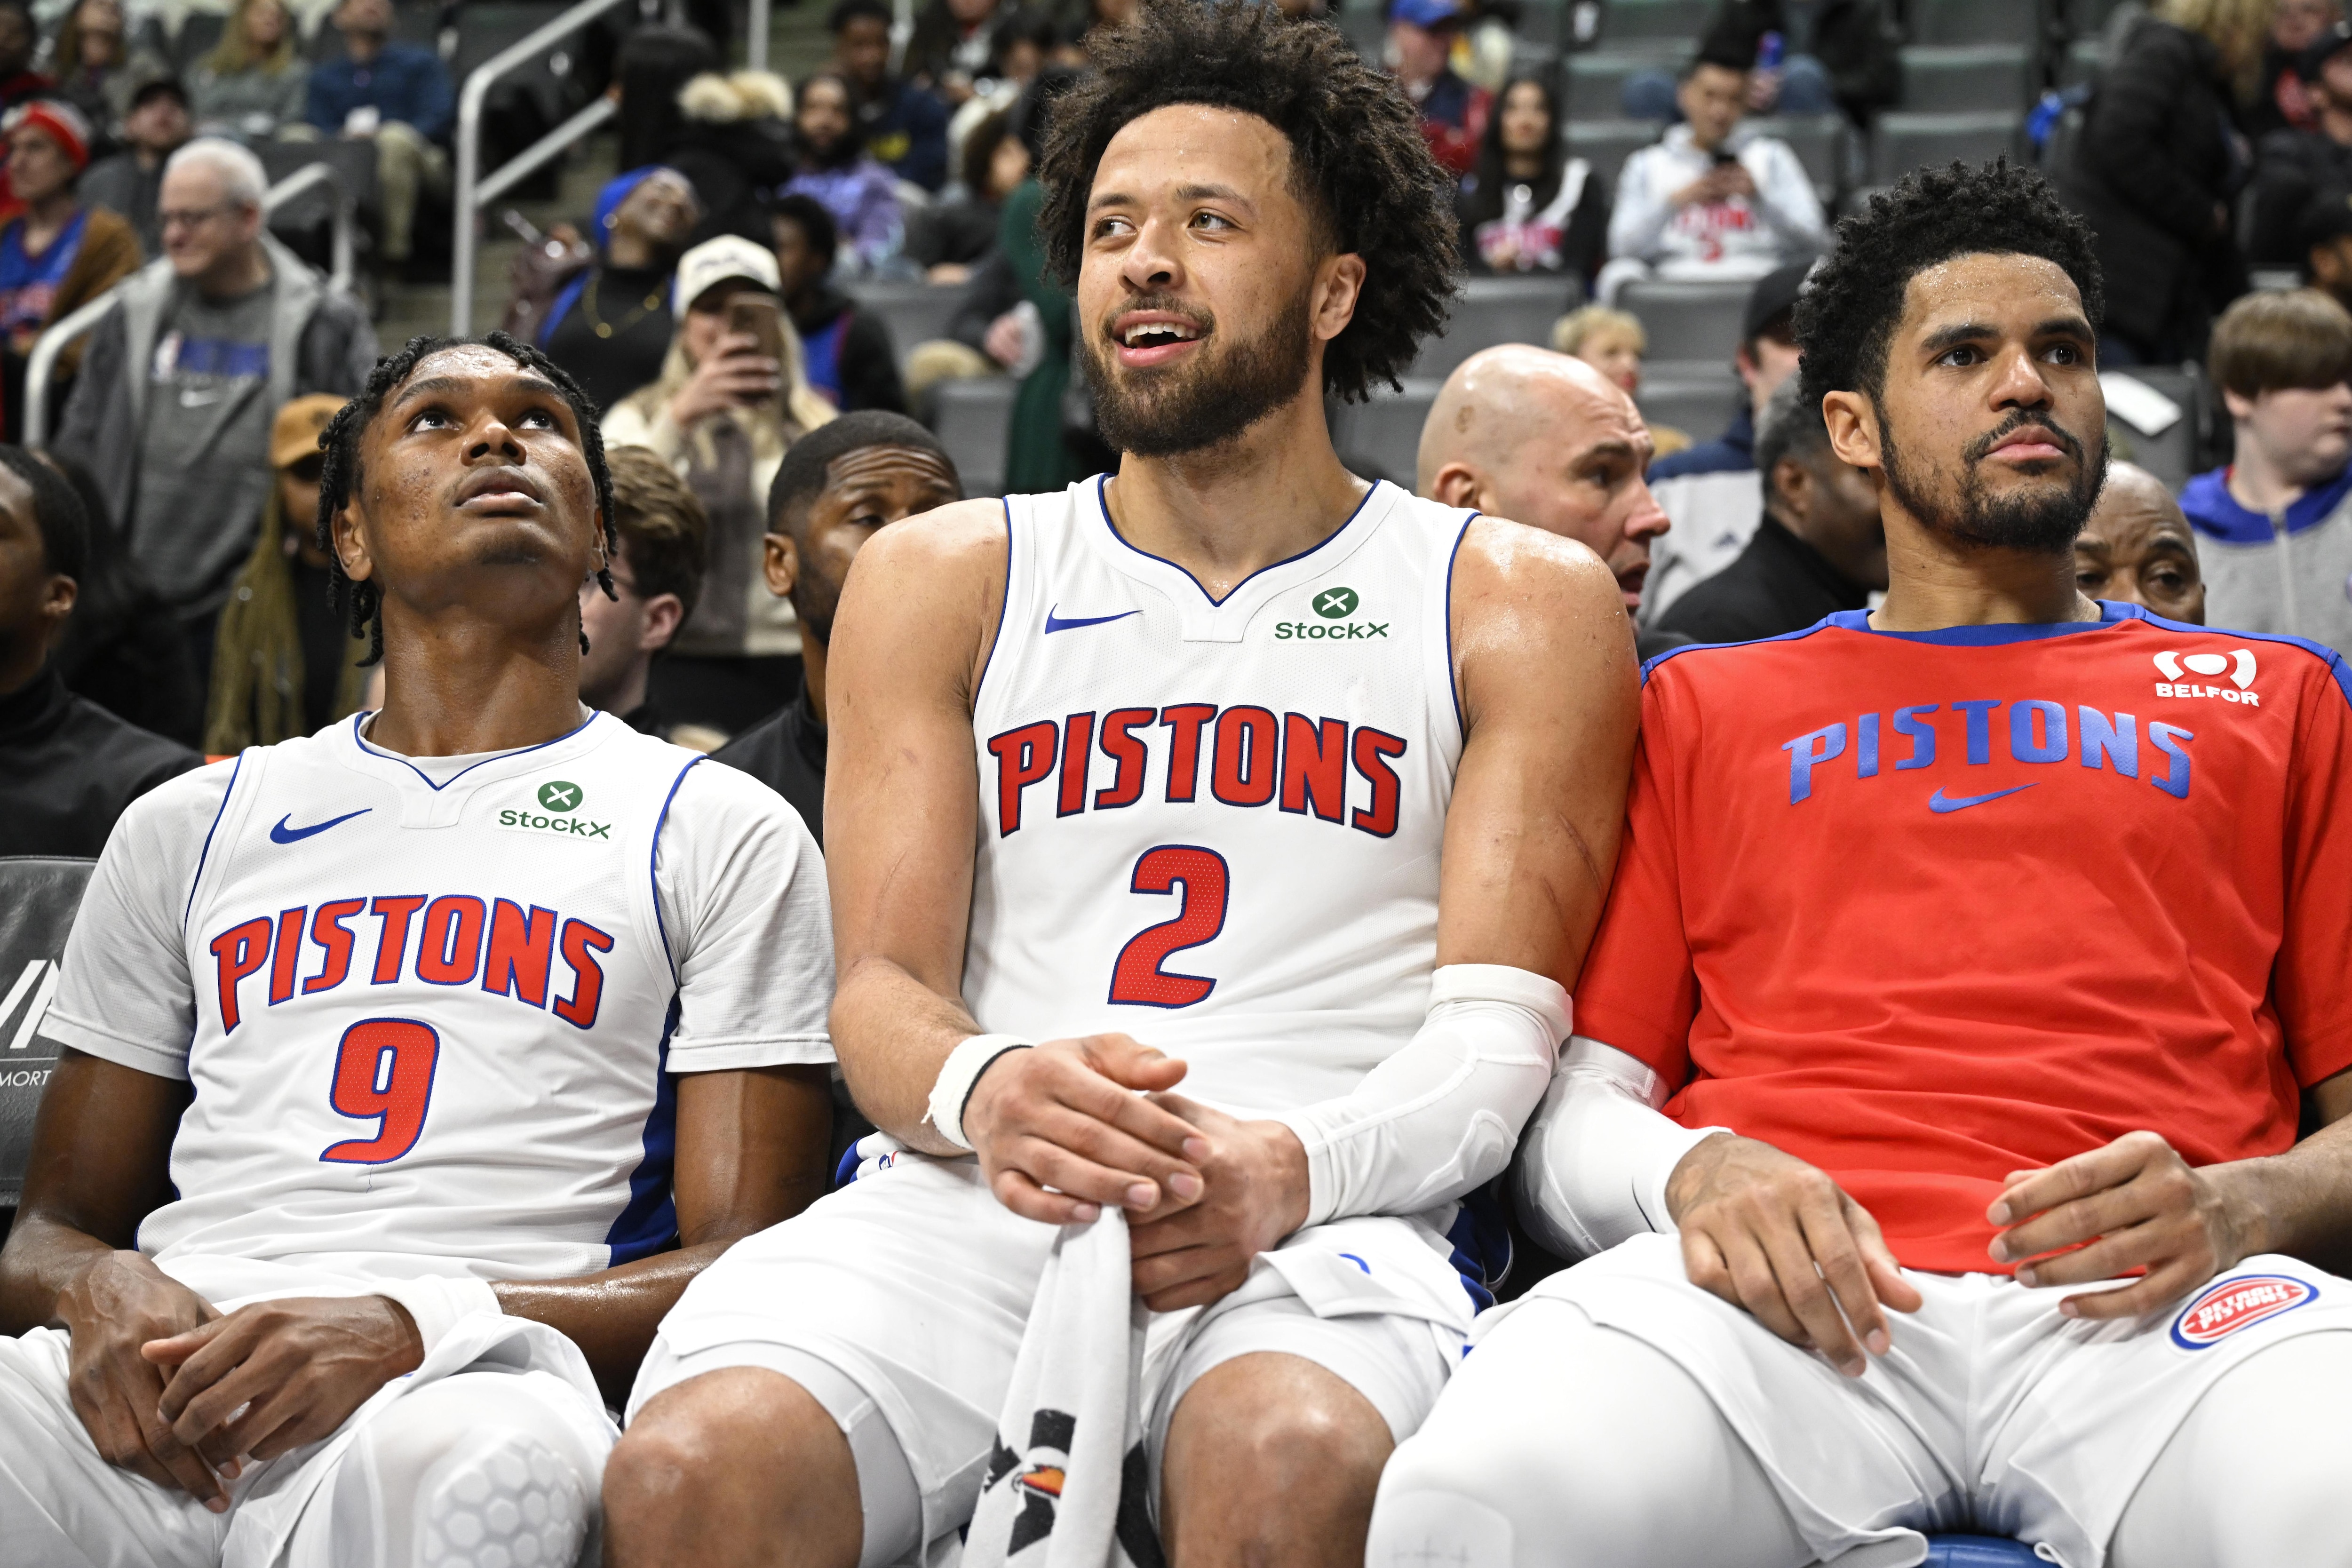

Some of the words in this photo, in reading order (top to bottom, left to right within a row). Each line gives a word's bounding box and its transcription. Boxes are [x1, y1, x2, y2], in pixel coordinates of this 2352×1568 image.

[1274, 621, 1389, 639] StockX
[1780, 699, 2195, 806] PISTONS
[2155, 682, 2260, 707] BELFOR
[499, 810, 612, 840] StockX
[987, 703, 1407, 839] PISTONS
[209, 894, 615, 1036] PISTONS
[1107, 844, 1230, 1010] 2
[319, 1017, 440, 1165] 9
